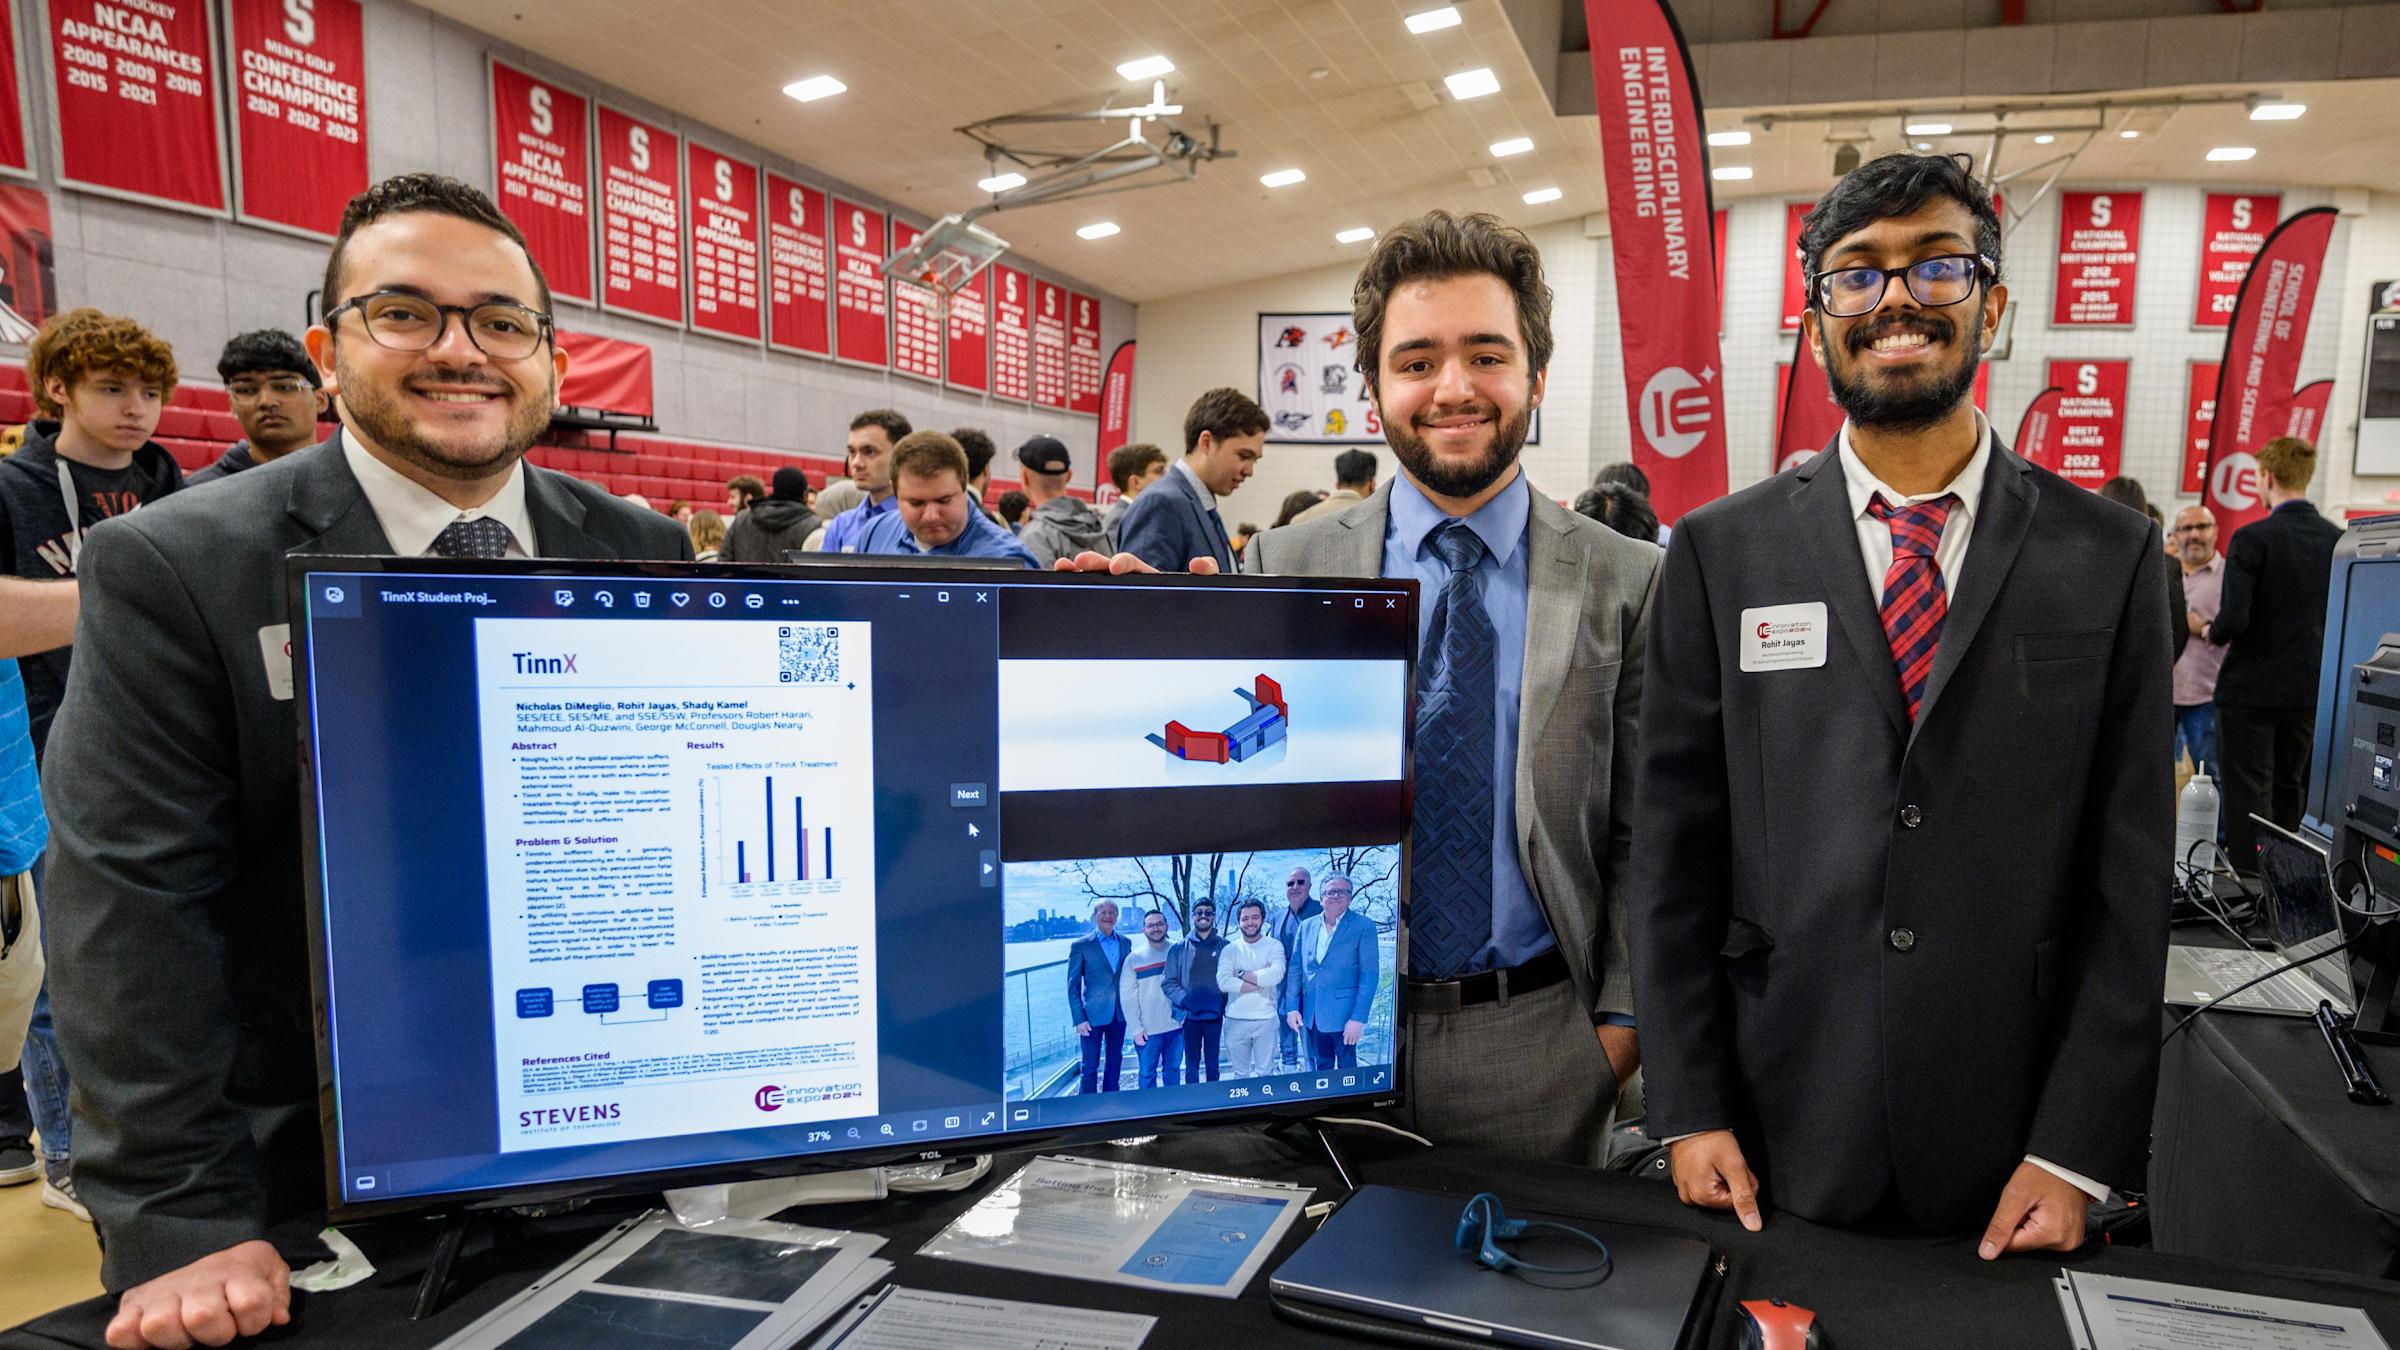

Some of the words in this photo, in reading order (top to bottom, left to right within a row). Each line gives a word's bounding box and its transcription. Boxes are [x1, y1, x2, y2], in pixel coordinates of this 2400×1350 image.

[94, 2, 168, 45] NCAA
[284, 0, 315, 46] S
[61, 17, 203, 75] APPEARANCES
[264, 38, 304, 65] MEN'S
[304, 52, 336, 75] GOLF
[62, 42, 109, 71] 2008
[115, 57, 157, 84] 2009
[165, 72, 203, 97] 2010
[242, 48, 358, 104] CONFERENCE
[67, 66, 109, 93] 2015
[118, 80, 157, 106] 2021
[243, 69, 358, 125] CHAMPIONS
[247, 93, 279, 119] 2021
[287, 107, 321, 132] 2022
[326, 120, 359, 144] 2023
[529, 85, 553, 136] S
[1619, 46, 1658, 219] ENGINEERING
[629, 125, 650, 172] S
[521, 147, 564, 179] NCAA
[1645, 46, 1690, 282] INTERDISCIPLINARY
[502, 160, 584, 200] APPEARANCES
[714, 158, 733, 202] S
[606, 178, 677, 215] CONFERENCE
[789, 187, 805, 227] S
[606, 194, 678, 230] CHAMPIONS
[2091, 195, 2112, 228] S
[2231, 198, 2253, 230] S
[851, 210, 867, 248] S
[2073, 229, 2126, 240] NATIONAL
[2071, 240, 2128, 251] CHAMPION
[2278, 263, 2305, 317] SCHOOL
[2252, 259, 2288, 354] ENGINEERING
[2274, 320, 2292, 341] OF
[2077, 364, 2099, 395] S
[2246, 354, 2265, 387] AND
[2057, 407, 2114, 418] CHAMPION
[2060, 397, 2112, 408] NATIONAL
[2236, 387, 2258, 444] SCIENCE
[2063, 454, 2101, 469] 2022
[380, 591, 415, 602] TinnX
[416, 592, 462, 603] Student
[1771, 621, 1812, 629] innovation
[1761, 640, 1781, 649] Rohit
[1782, 639, 1806, 648] Jayas
[512, 652, 578, 674] TinnX
[516, 702, 562, 711] Nicholas
[565, 702, 615, 712] DiMeglio,
[617, 701, 645, 710] Rohit
[648, 701, 680, 711] Jayas,
[682, 701, 714, 711] Shady
[717, 700, 748, 709] Kamel
[516, 712, 565, 722] SES/ECE,
[568, 712, 613, 721] SES/ME,
[615, 712, 635, 721] and
[637, 711, 687, 721] SSE/SSW,
[690, 711, 744, 720] Professors
[746, 711, 780, 719] Robert
[781, 711, 814, 720] Harari,
[517, 723, 571, 733] Mahmoud
[574, 723, 633, 732] Al-Quzwini,
[636, 723, 672, 733] George
[675, 722, 728, 731] McConnell,
[731, 721, 771, 731] Douglas
[774, 721, 803, 730] Neary
[511, 742, 557, 750] Abstract
[687, 741, 725, 749] Results
[706, 763, 733, 771] Tested
[736, 762, 763, 770] Effects
[775, 761, 797, 769] TinnX
[957, 789, 980, 800] Next
[516, 837, 561, 846] Problem
[575, 836, 618, 844] Solution
[522, 1055, 581, 1066] References
[584, 1052, 610, 1060] Cited
[786, 1082, 862, 1095] innovation
[786, 1091, 862, 1104] expo2024
[1229, 1087, 1249, 1098] 23%
[519, 1103, 621, 1127] STEVENS
[573, 1121, 622, 1130] TECHNOLOGY
[808, 1130, 831, 1143] 37%
[920, 1151, 941, 1160] TCL
[2173, 1297, 2230, 1313] Prototype
[2232, 1306, 2267, 1316] Costs
